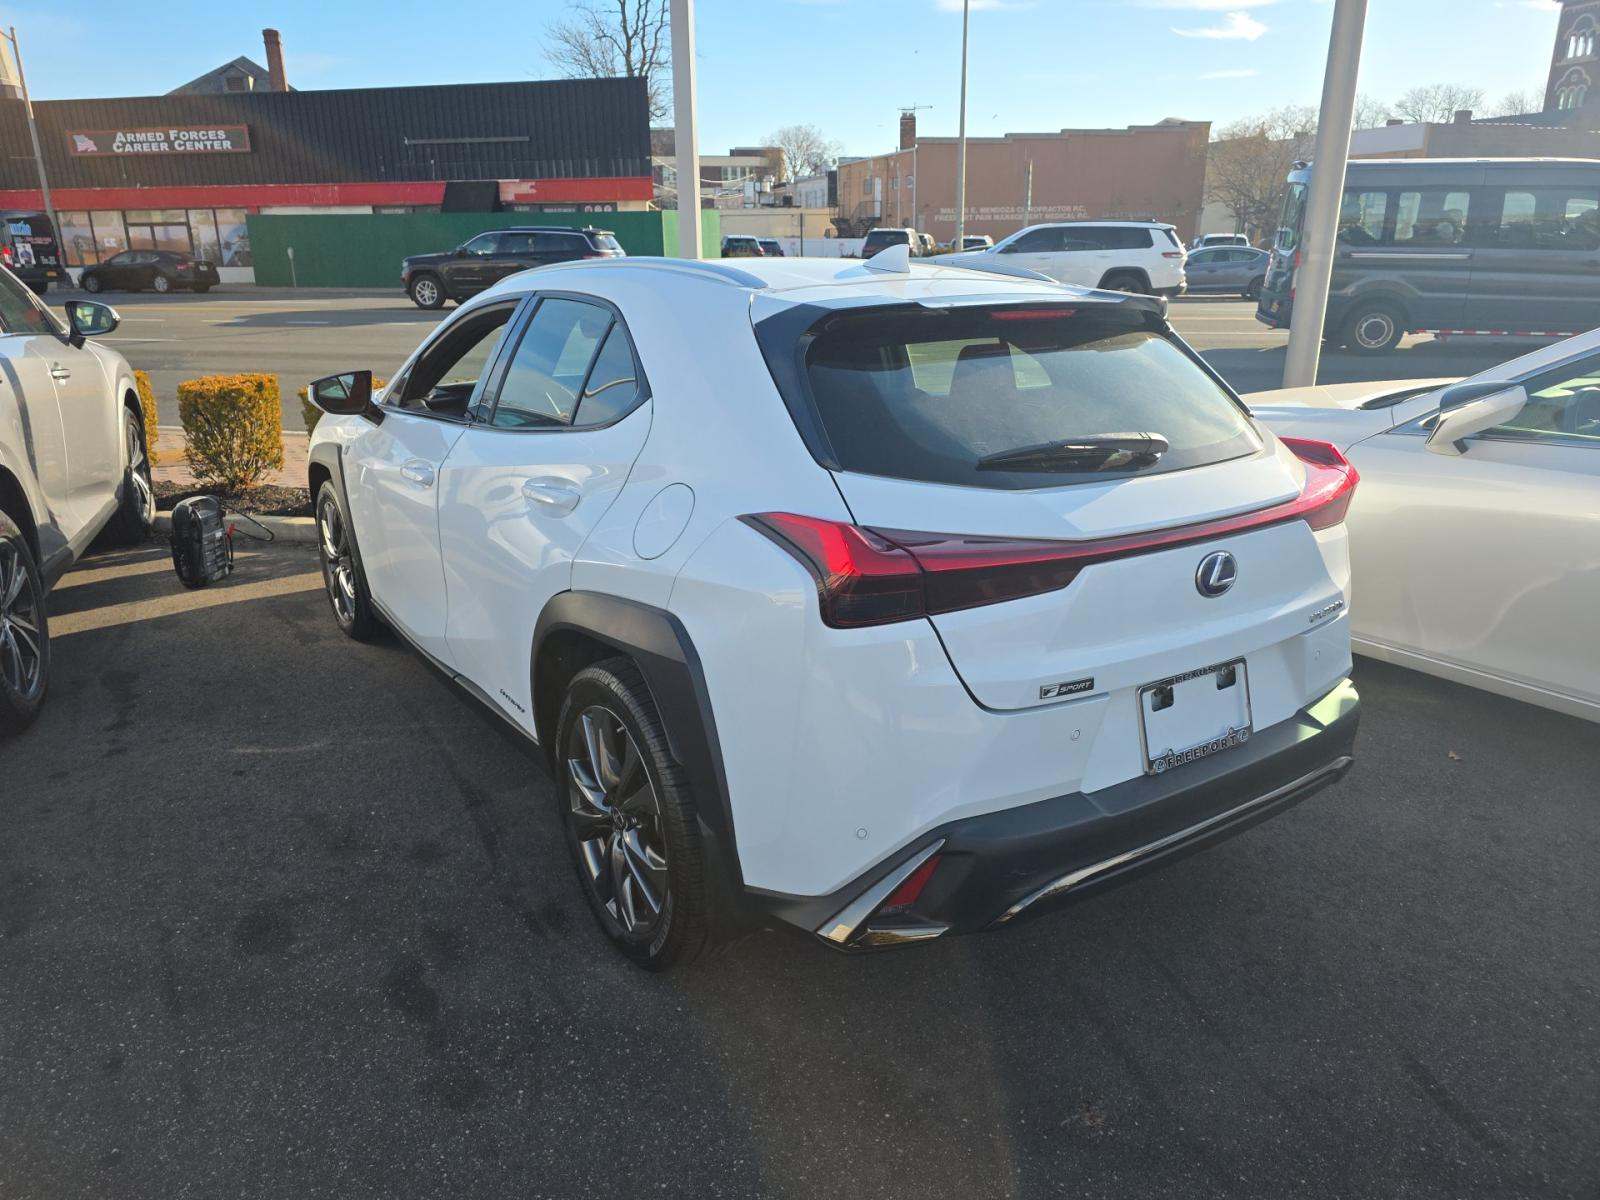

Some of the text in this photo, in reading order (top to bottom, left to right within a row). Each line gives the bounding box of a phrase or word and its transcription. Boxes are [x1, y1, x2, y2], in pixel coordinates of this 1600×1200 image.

[115, 129, 226, 143] ARMED FORCES
[112, 139, 232, 153] CAREER CENTER
[1059, 680, 1092, 693] SPORT
[1166, 735, 1238, 768] FREEPORT
